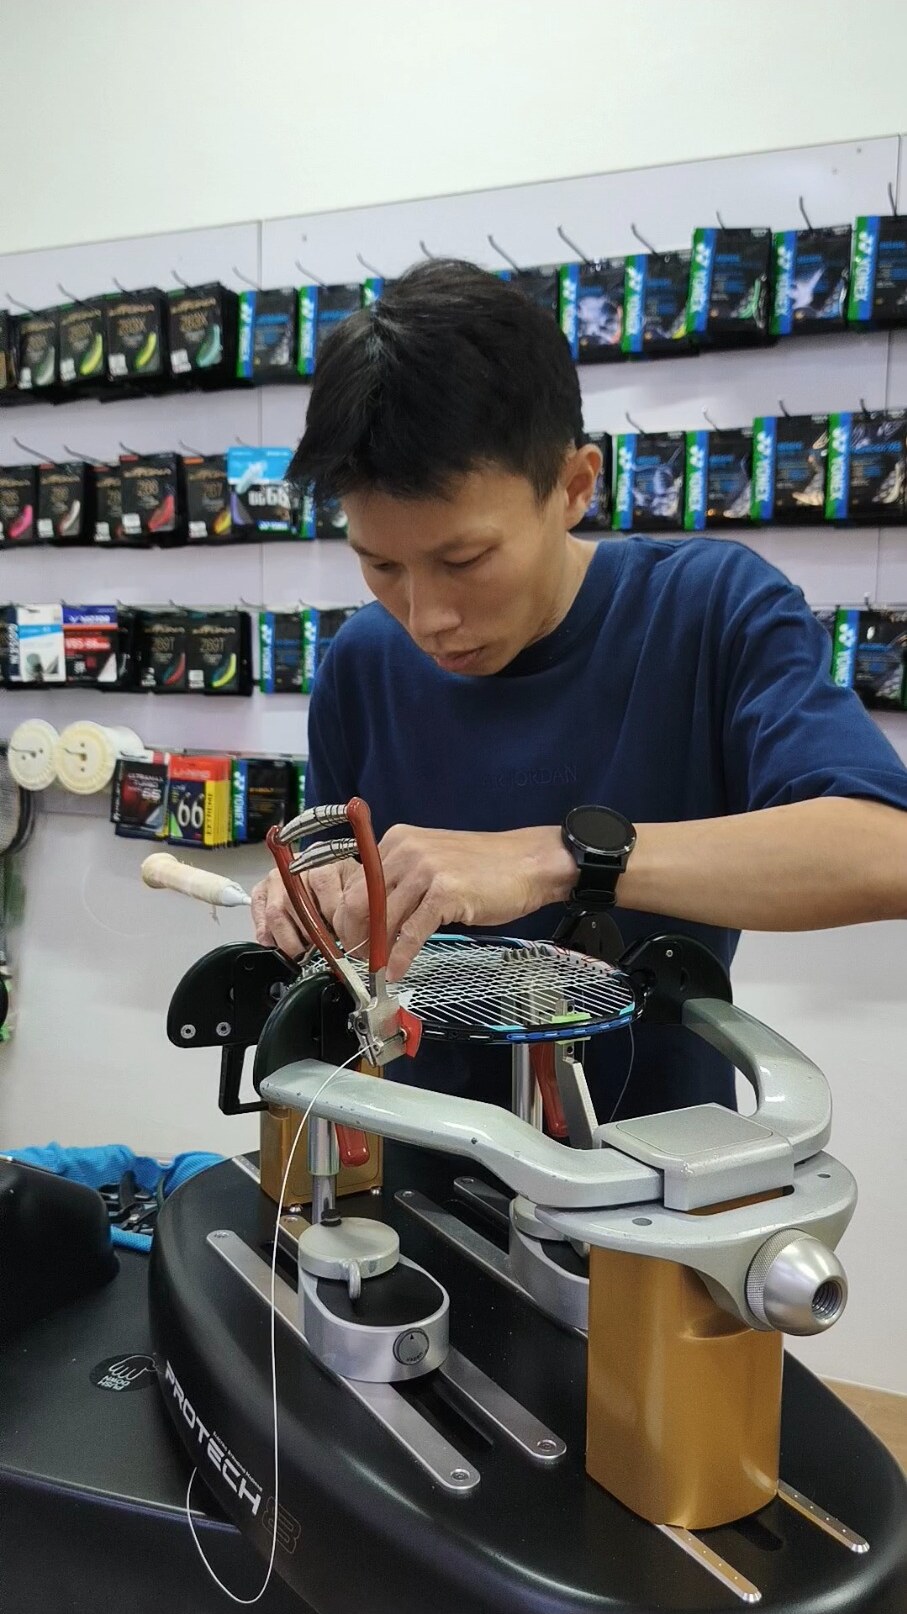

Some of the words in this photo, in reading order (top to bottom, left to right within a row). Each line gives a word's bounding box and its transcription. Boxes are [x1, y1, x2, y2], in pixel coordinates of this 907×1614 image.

[177, 797, 204, 829] 66
[234, 794, 245, 827] YONEX
[97, 1379, 127, 1391] PUSH
[165, 1360, 261, 1516] PROTECH
